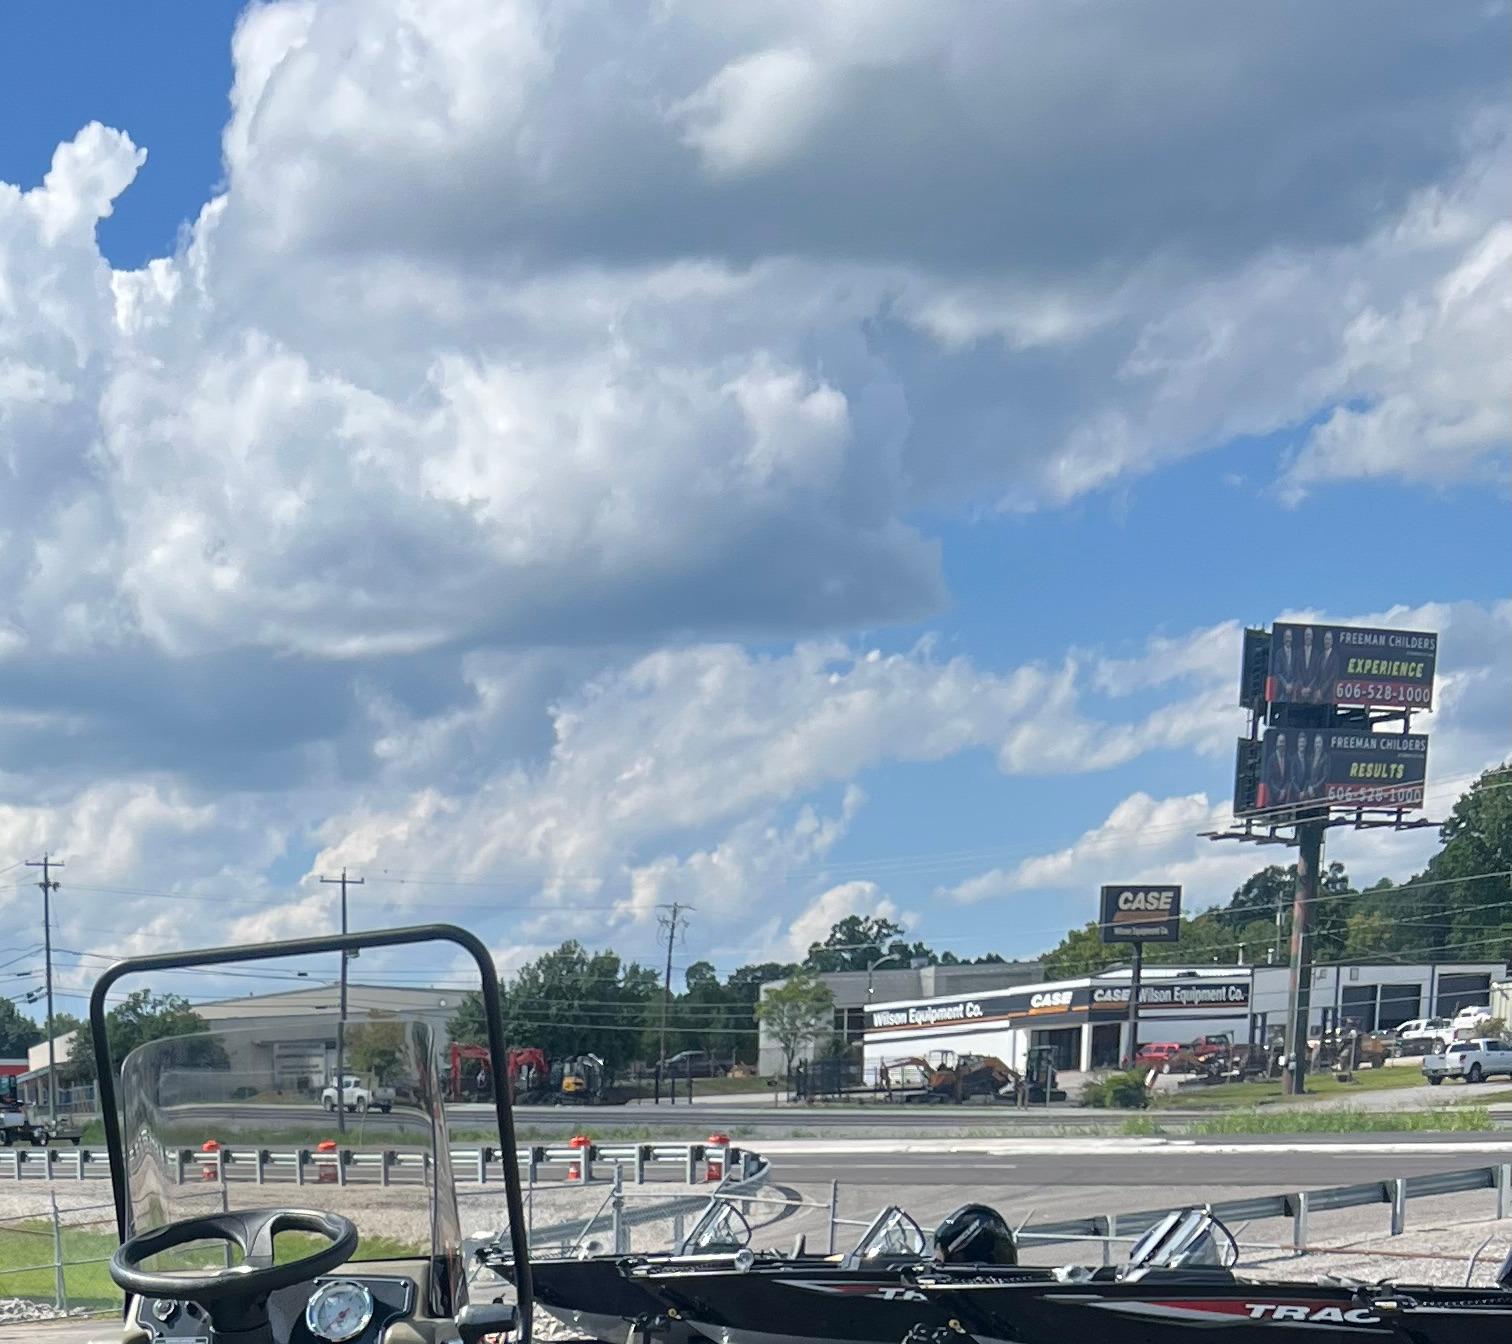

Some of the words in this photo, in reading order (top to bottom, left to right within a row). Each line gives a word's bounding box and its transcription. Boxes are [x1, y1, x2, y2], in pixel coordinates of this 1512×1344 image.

[1339, 631, 1385, 647] FREEMAN
[1388, 636, 1436, 650] CHILDERS
[1347, 658, 1425, 678] EXPERIENCE
[1336, 683, 1431, 702] 606-528-1000
[1330, 736, 1376, 749] FREEMAN
[1379, 738, 1426, 751] CHILDERS
[1349, 762, 1405, 779] RESULTS
[1118, 891, 1174, 911] CASE
[1030, 991, 1073, 1008] CASE
[1094, 989, 1131, 1002] CASE
[1138, 986, 1171, 1003] Wilson
[1173, 987, 1225, 1004] Equipment
[1227, 987, 1246, 1001] Co.
[873, 1009, 907, 1027] Wilson
[908, 1003, 964, 1026] Equipment
[965, 1001, 984, 1018] Co.
